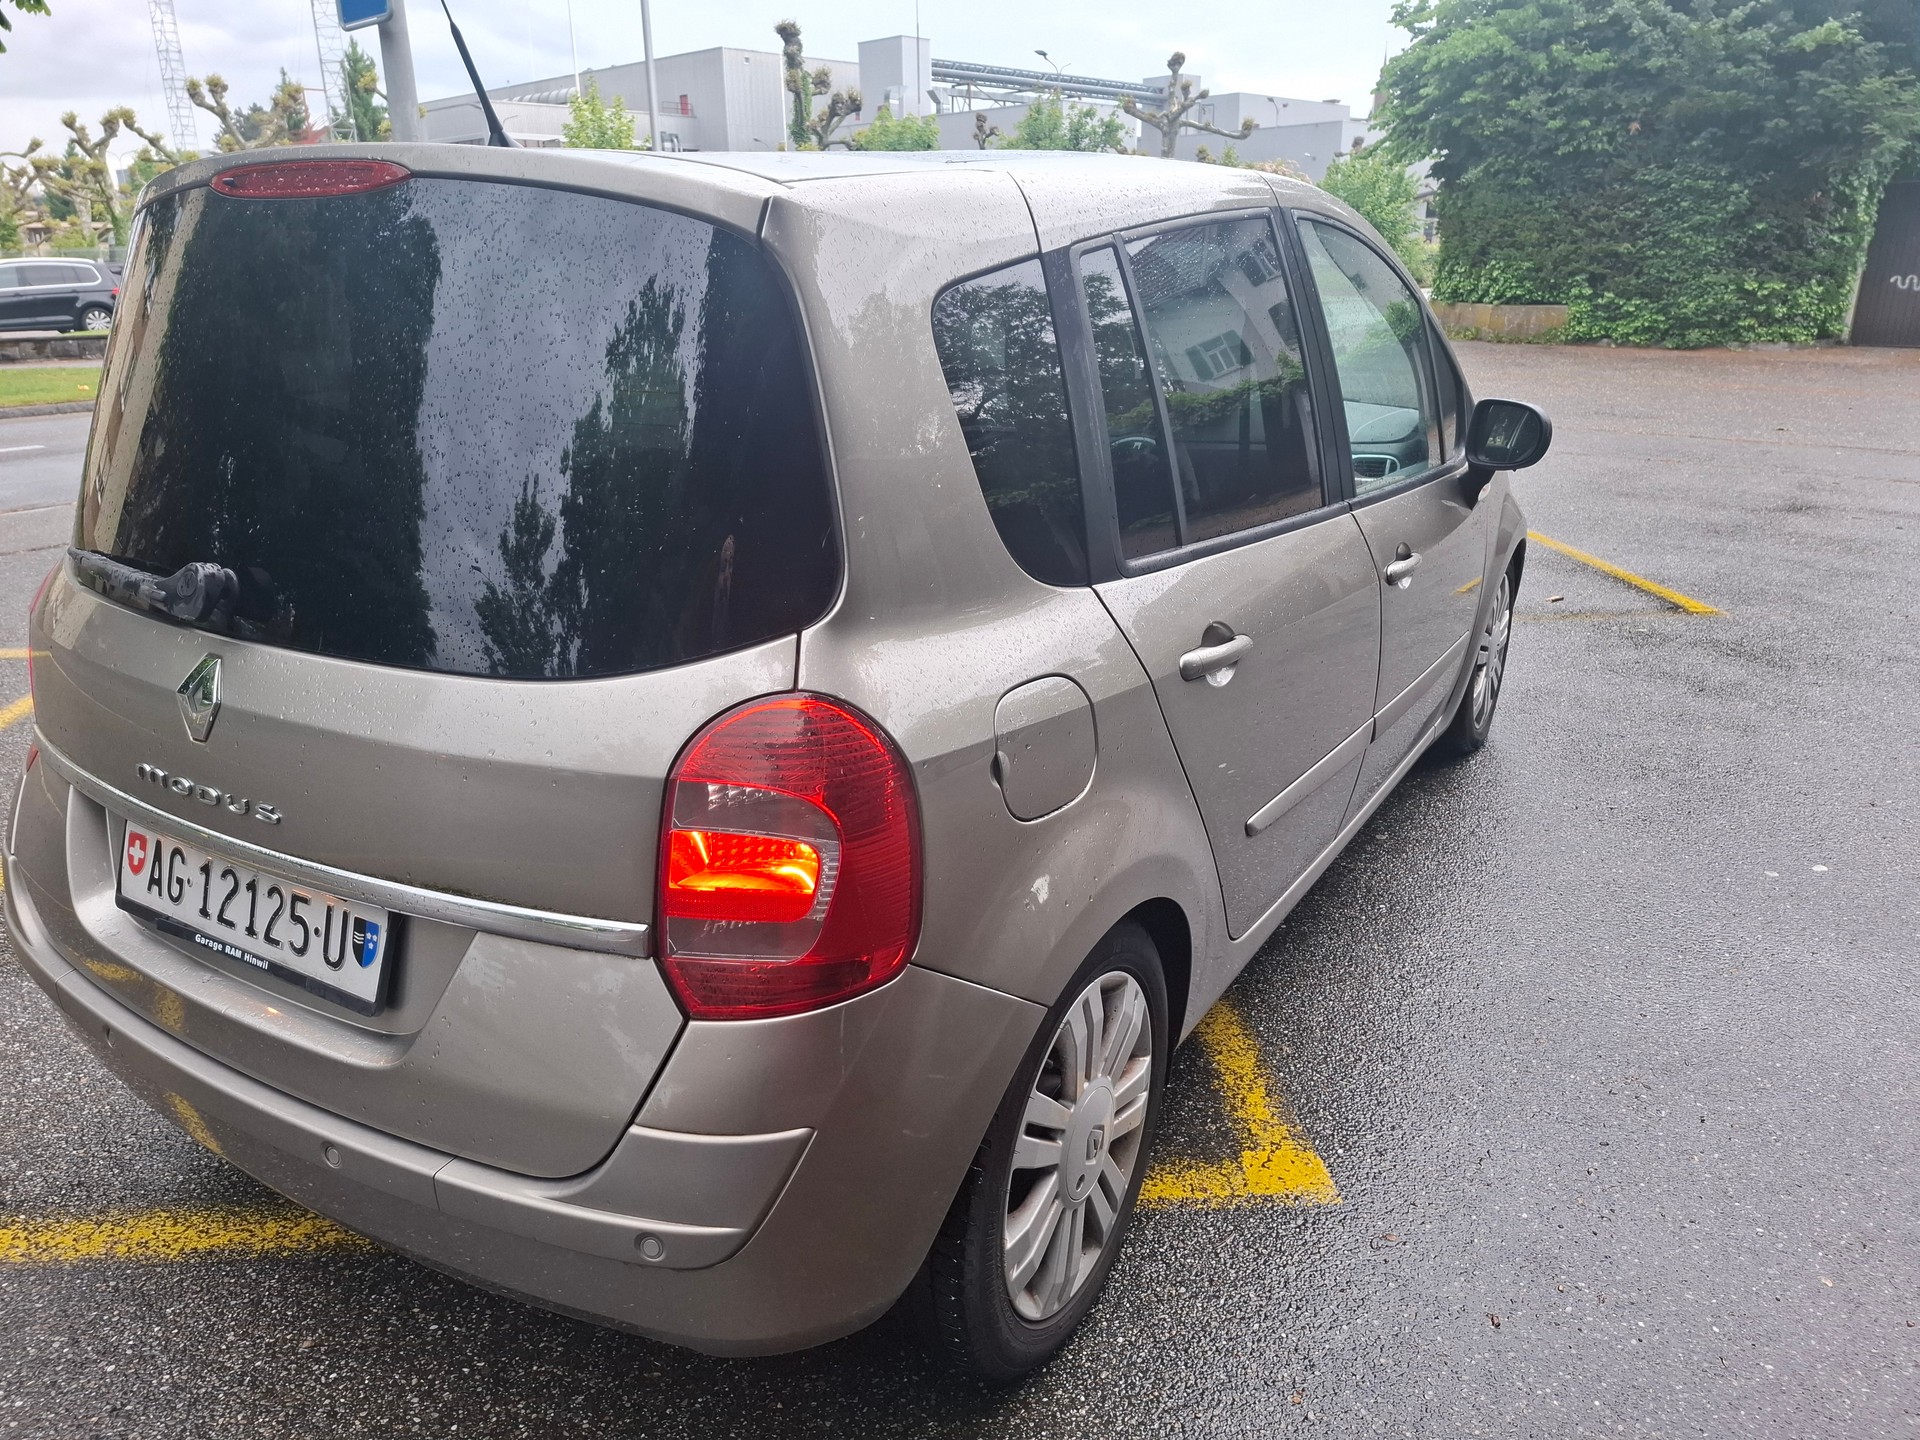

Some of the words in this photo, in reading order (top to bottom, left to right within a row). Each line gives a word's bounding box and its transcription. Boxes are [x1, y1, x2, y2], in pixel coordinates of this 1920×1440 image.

[195, 934, 223, 951] Garage
[225, 945, 242, 959] RAM
[244, 952, 269, 970] Hinwil
